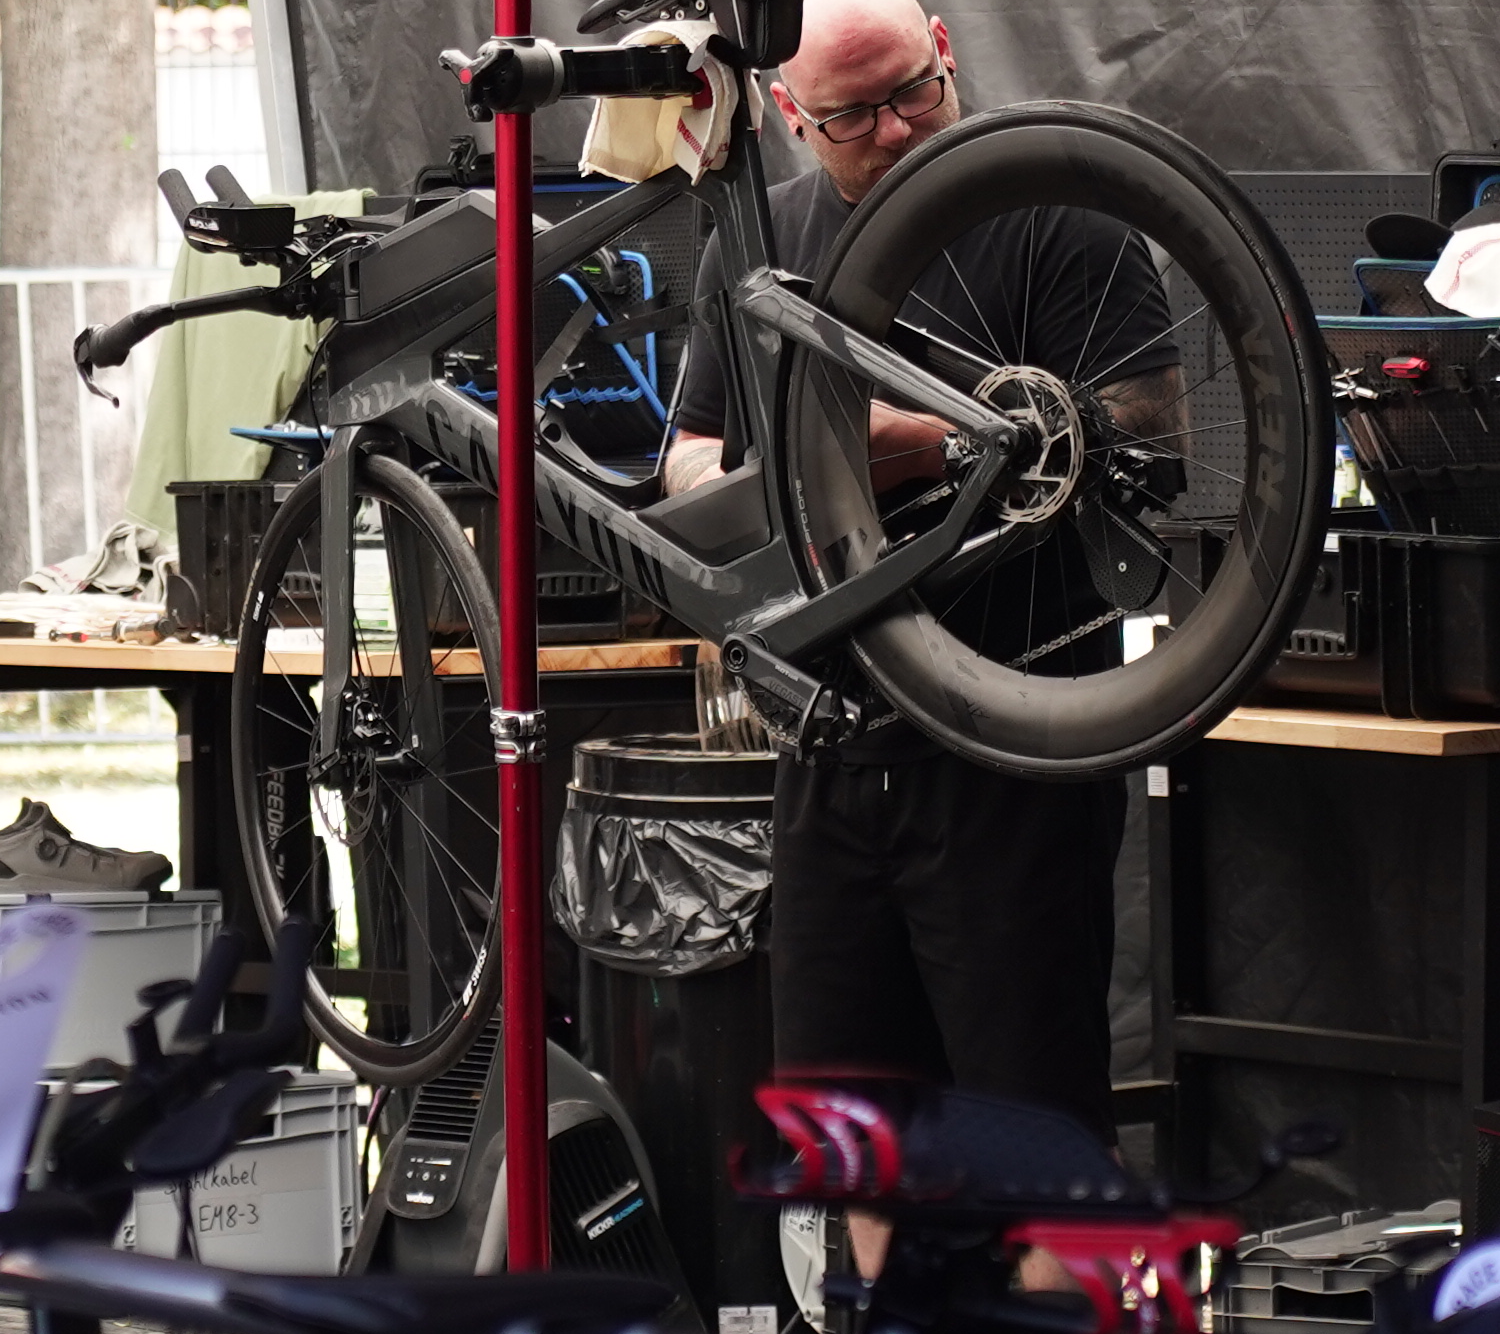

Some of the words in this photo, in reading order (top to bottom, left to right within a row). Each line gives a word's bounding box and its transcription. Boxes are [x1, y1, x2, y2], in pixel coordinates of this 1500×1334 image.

[426, 399, 672, 610] CAYON
[199, 1204, 259, 1232] EM8-3
[587, 1216, 615, 1241] KICKR
